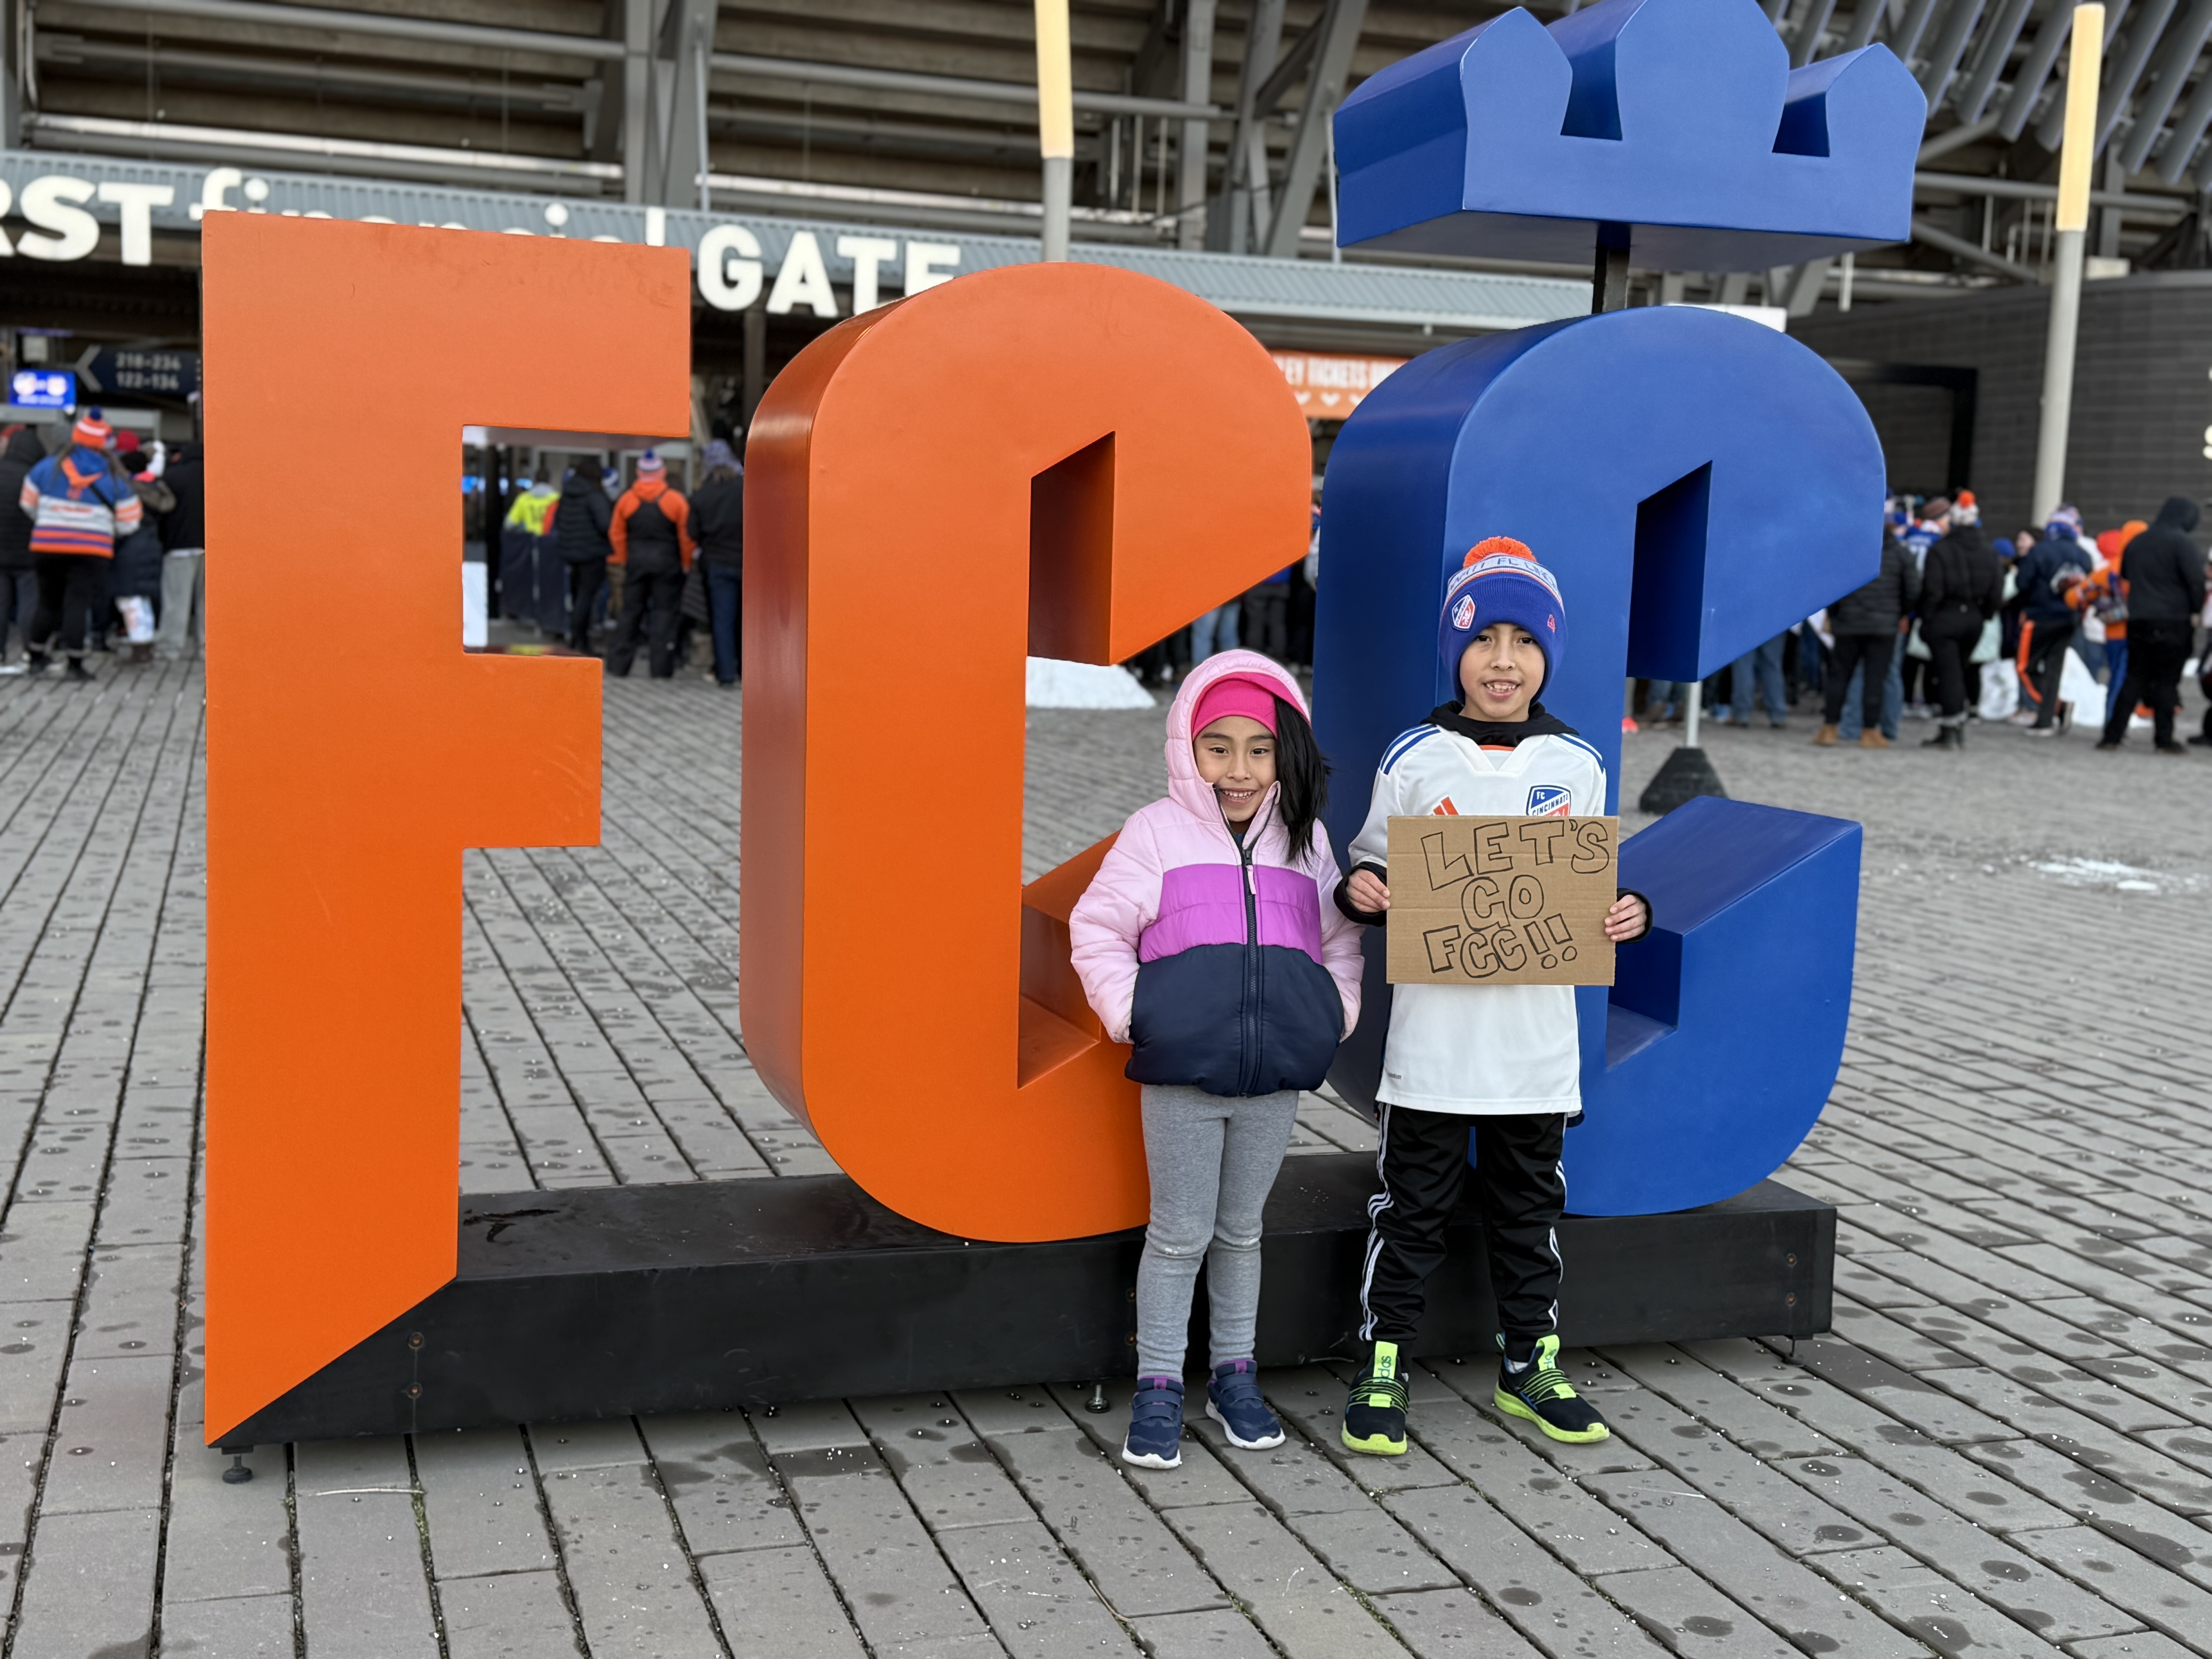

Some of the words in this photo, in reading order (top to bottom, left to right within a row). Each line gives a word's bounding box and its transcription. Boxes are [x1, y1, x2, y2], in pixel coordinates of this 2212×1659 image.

[1532, 793, 1568, 816] CINCINNATI
[1537, 791, 1545, 800] FC
[1421, 819, 1609, 891] LET'S
[1461, 874, 1544, 932] GO
[1423, 913, 1577, 978] FCC!!
